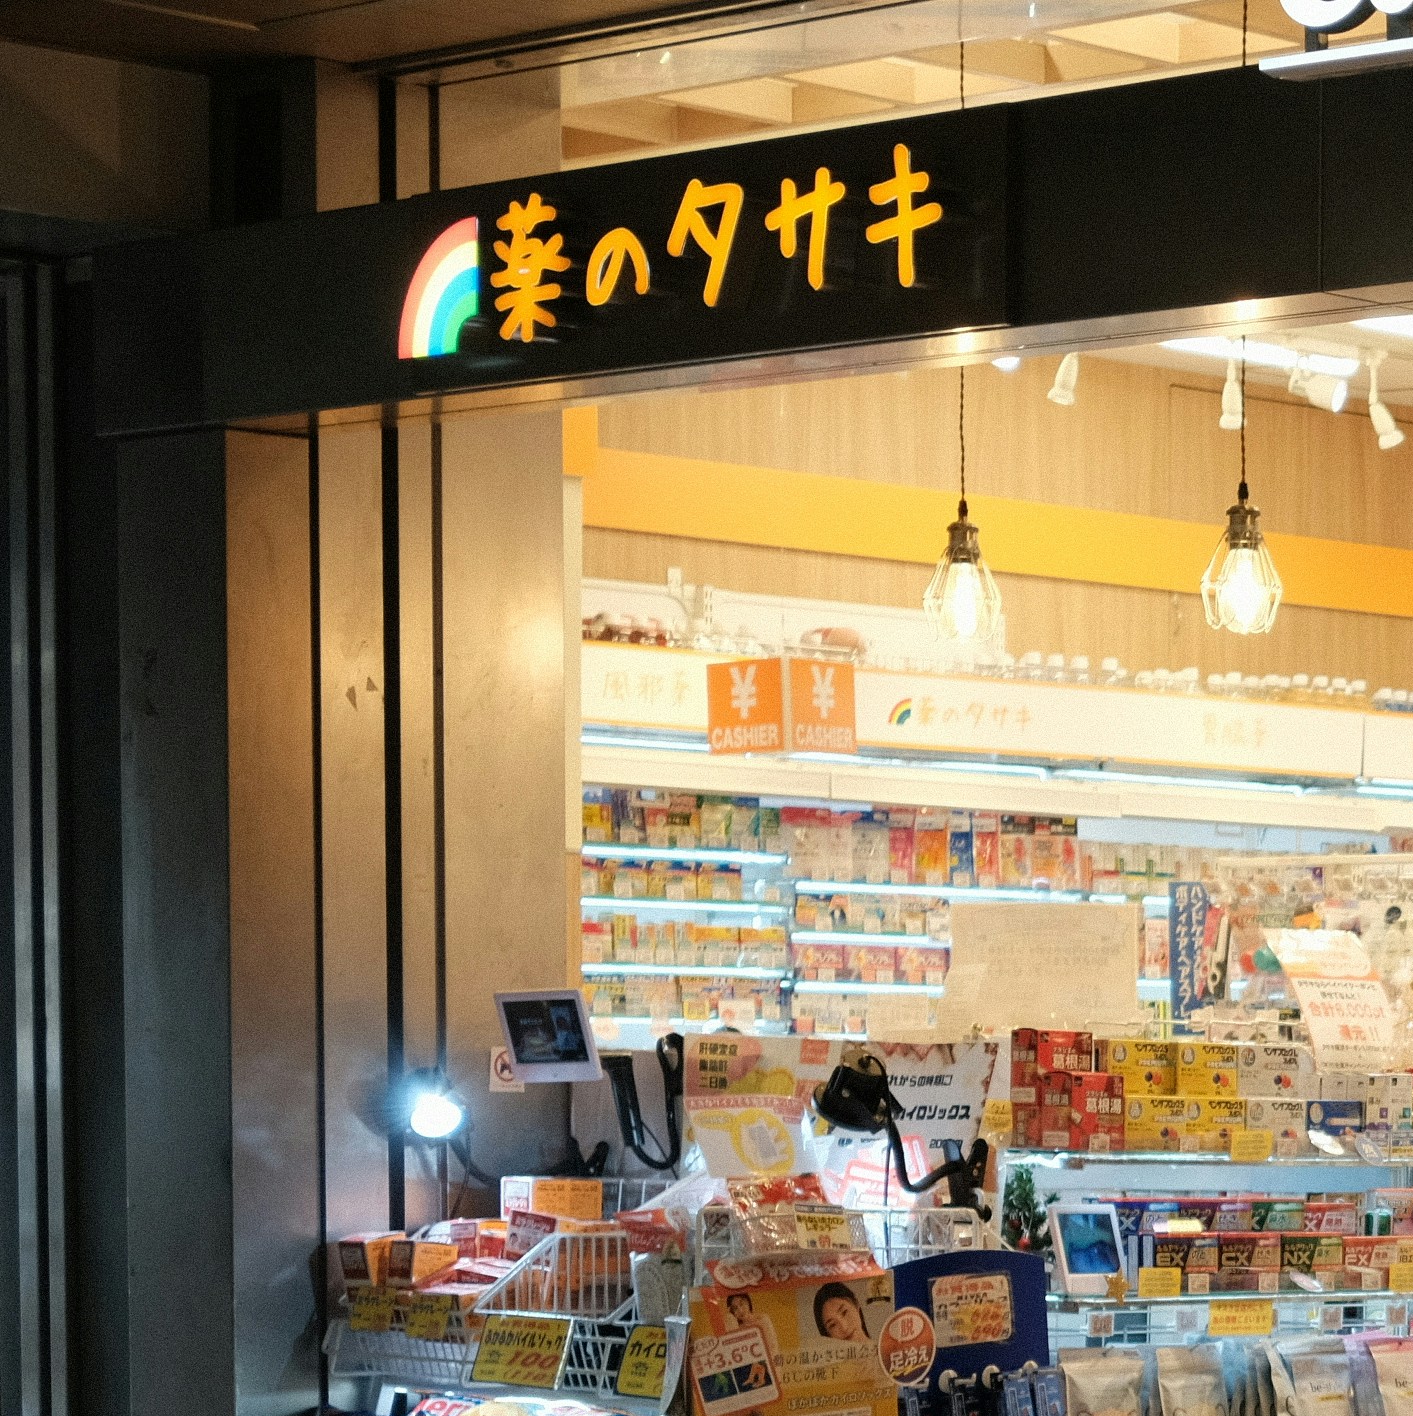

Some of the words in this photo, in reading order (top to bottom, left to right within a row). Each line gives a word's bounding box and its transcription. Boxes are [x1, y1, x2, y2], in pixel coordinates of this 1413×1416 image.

[189, 143, 943, 343] 薬のタサキ
[711, 724, 779, 750] CASHIER
[795, 724, 856, 751] CASHIER
[1052, 1054, 1092, 1070] 葛根湯
[1085, 1098, 1122, 1115] 葛根湯
[1155, 1253, 1186, 1267] EX
[1221, 1253, 1250, 1267] CX
[1282, 1252, 1313, 1266] NX
[899, 1320, 915, 1338] 脱
[889, 1350, 931, 1371] 足冷え
